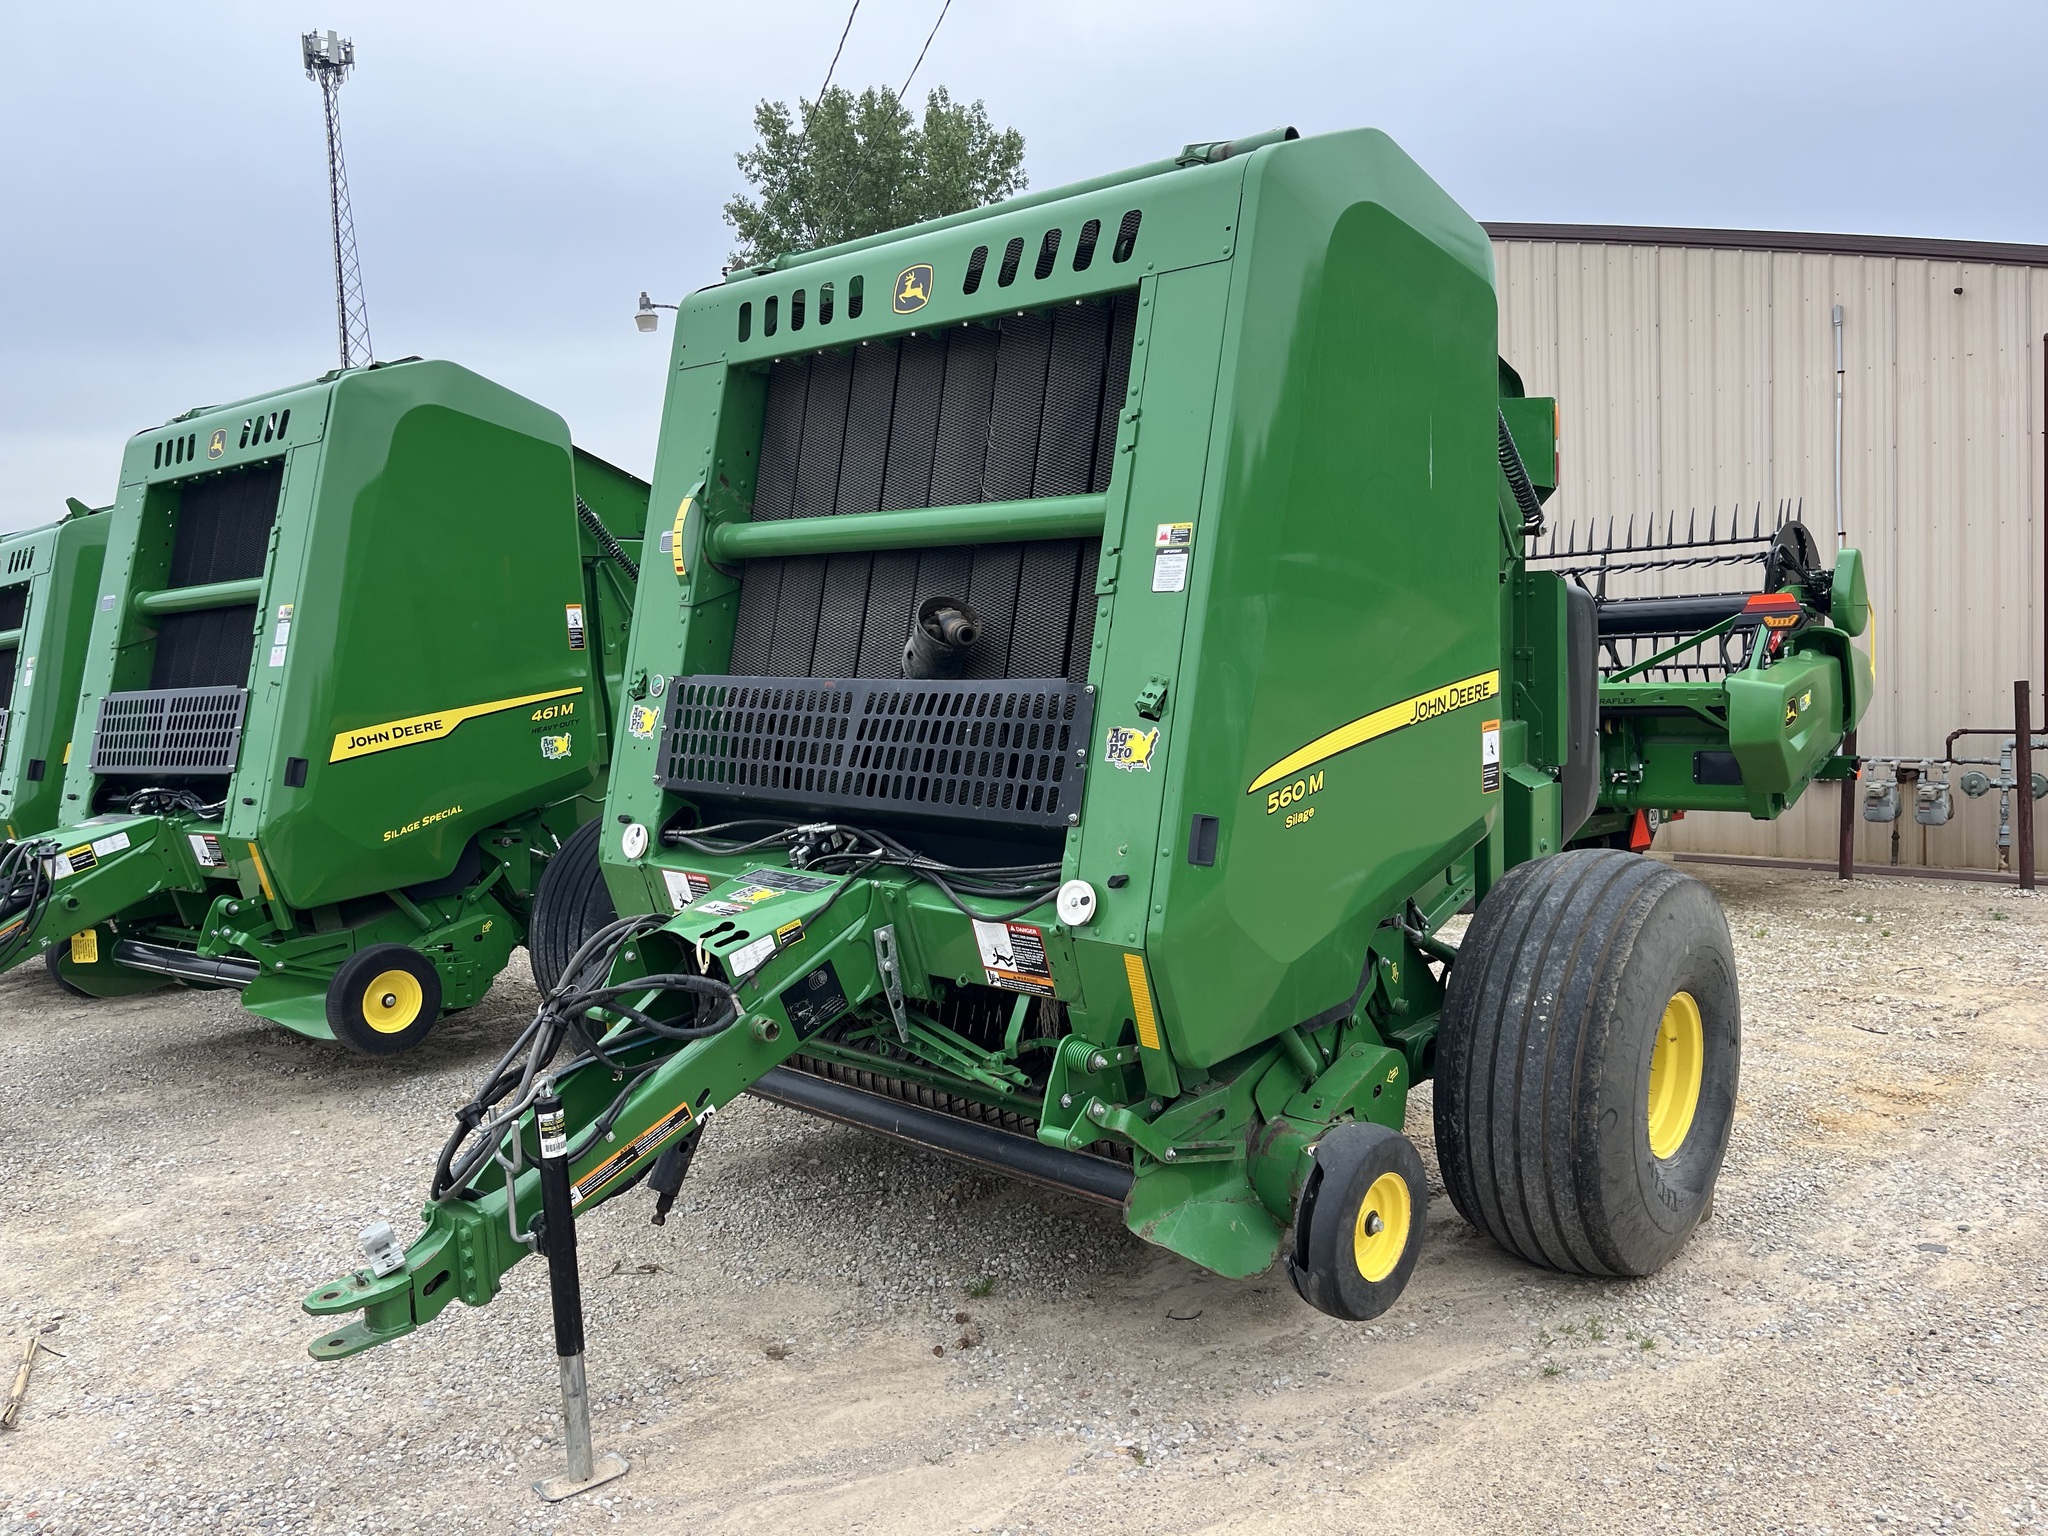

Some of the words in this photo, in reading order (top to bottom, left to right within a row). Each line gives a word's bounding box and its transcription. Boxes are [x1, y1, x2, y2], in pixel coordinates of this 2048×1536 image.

[1410, 695, 1446, 723] JOHN
[1450, 681, 1490, 708] DEERE
[1599, 697, 1636, 705] RAFLEX
[531, 705, 559, 722] 461
[560, 702, 574, 716] M
[531, 718, 580, 734] HEAVY-DUTY
[630, 718, 645, 730] Pro
[347, 730, 390, 750] JOHN
[392, 719, 444, 740] DEERE
[1109, 728, 1134, 747] Ag-
[1107, 743, 1132, 759] Pro
[1267, 780, 1306, 815] 560
[1308, 769, 1325, 796] M
[383, 821, 421, 842] SILAGE
[422, 805, 463, 827] SPECIAL
[1284, 806, 1316, 830] Silage
[1650, 810, 1658, 821] 20
[1015, 926, 1038, 935] DANGER
